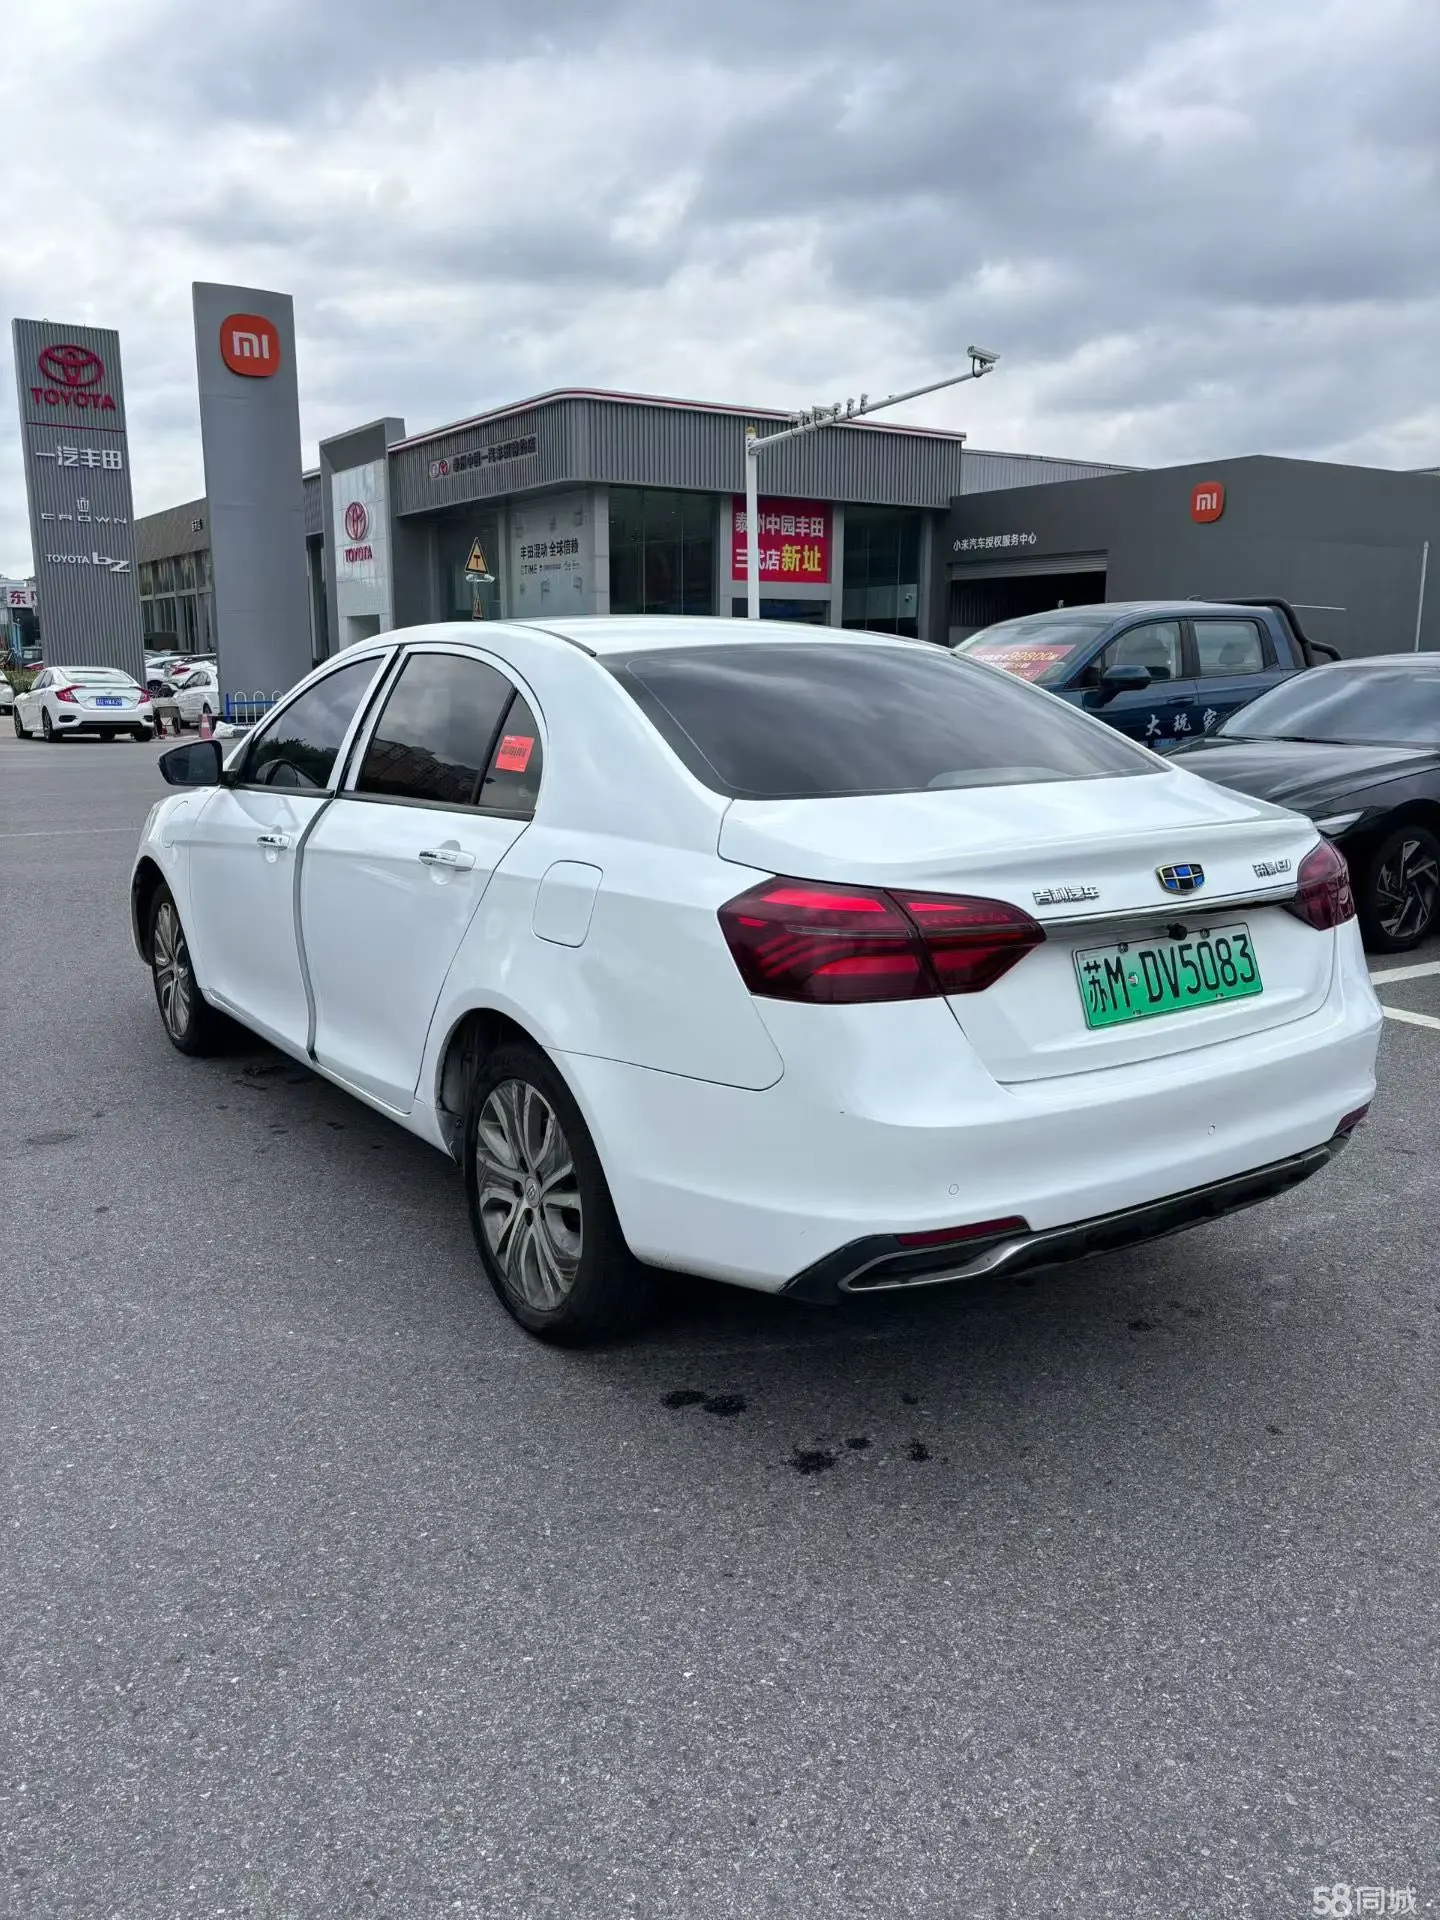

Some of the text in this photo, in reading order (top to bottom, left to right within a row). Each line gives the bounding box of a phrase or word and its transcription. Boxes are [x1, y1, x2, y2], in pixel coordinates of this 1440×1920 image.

[31, 387, 117, 411] TOYOTA
[35, 445, 123, 470] 一汽丰田
[40, 512, 128, 525] CROWN
[952, 531, 1038, 552] 小米汽车授权服务中心
[45, 554, 90, 564] TOYOTA
[345, 545, 373, 563] TOYOTA
[1031, 886, 1100, 906] 吉利汽车
